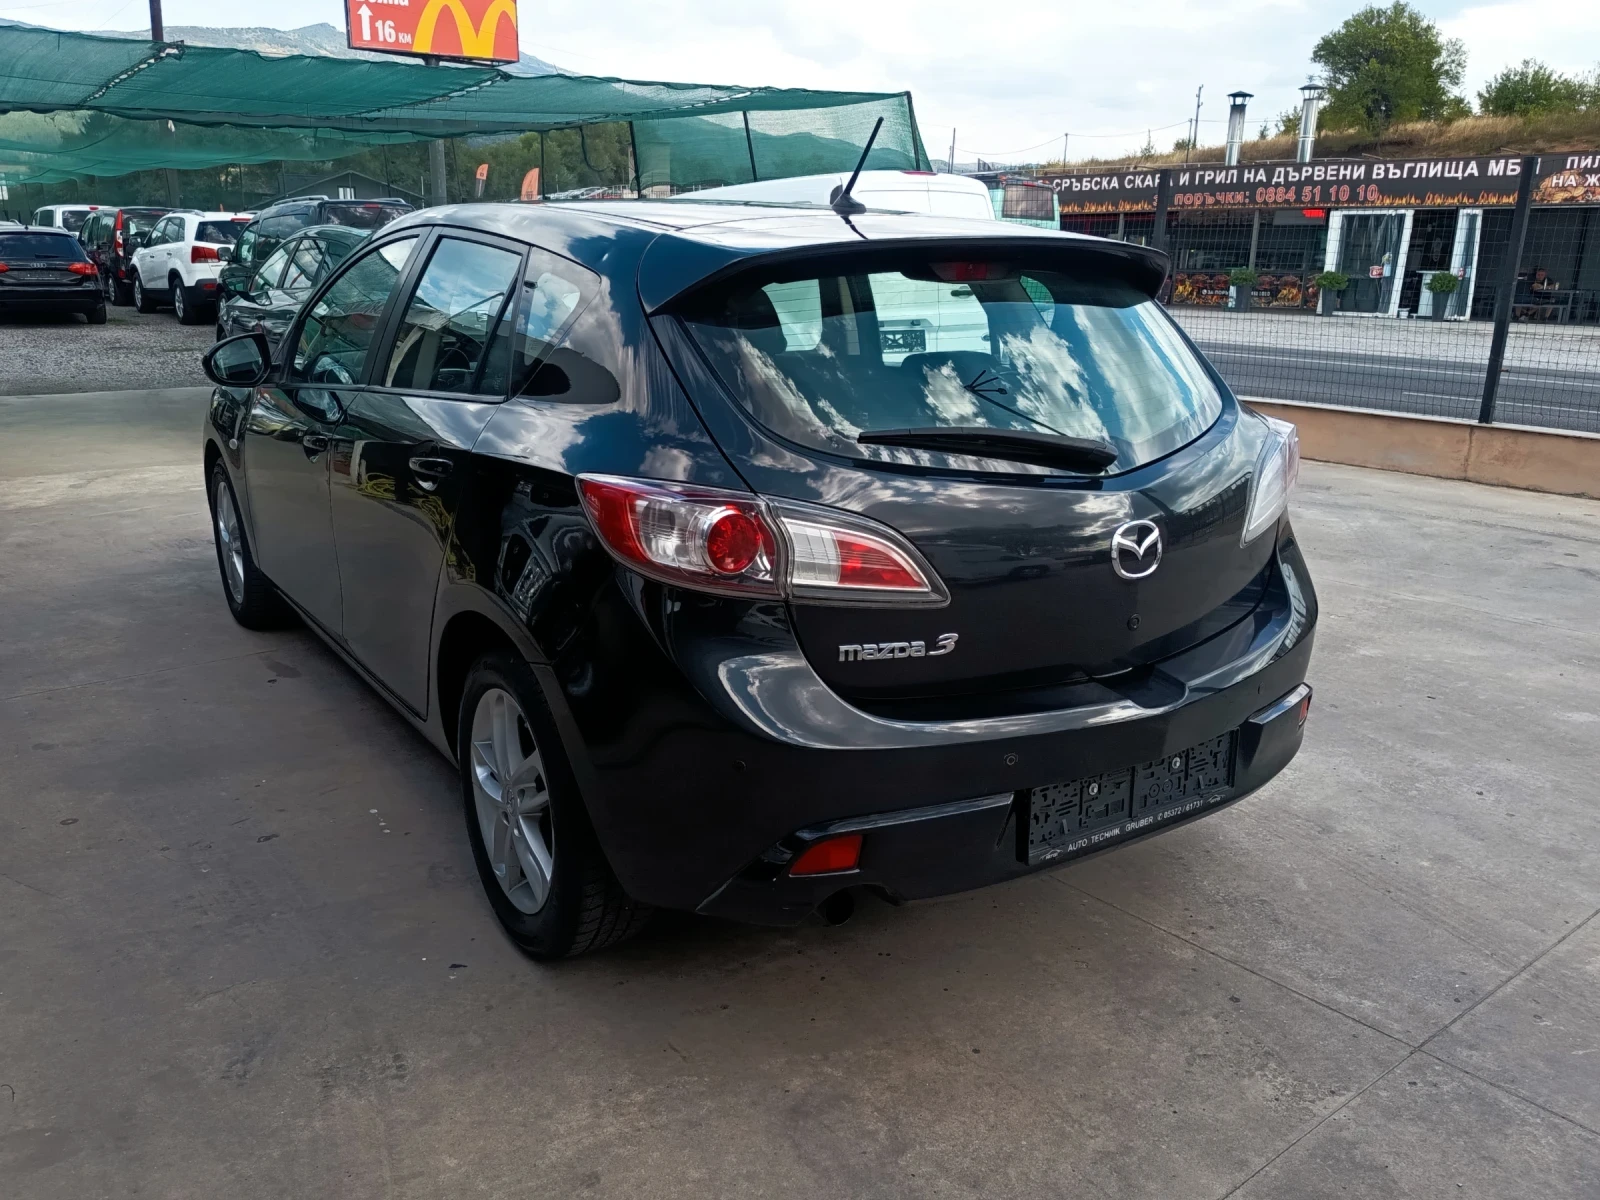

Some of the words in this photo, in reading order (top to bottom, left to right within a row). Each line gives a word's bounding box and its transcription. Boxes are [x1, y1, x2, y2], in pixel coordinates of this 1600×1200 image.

[375, 20, 396, 43] 16
[1053, 175, 1119, 192] СРЪБСКА
[1179, 172, 1190, 186] И
[1195, 169, 1238, 185] ГРИЛ
[1243, 168, 1267, 183] НА
[1272, 164, 1366, 185] ДЪРВЕНИ
[1372, 161, 1479, 180] ВЪГЛИЩА
[1551, 175, 1577, 188] НА
[1174, 191, 1250, 208] поръчки:
[1255, 186, 1296, 203] 0884
[1301, 186, 1321, 202] 51
[1329, 184, 1350, 202] 10
[1357, 183, 1378, 201] 10
[926, 632, 959, 656] 3
[1067, 839, 1088, 853] AUTO
[1091, 827, 1121, 844] TECHNIK
[1125, 816, 1154, 832] GRUBER
